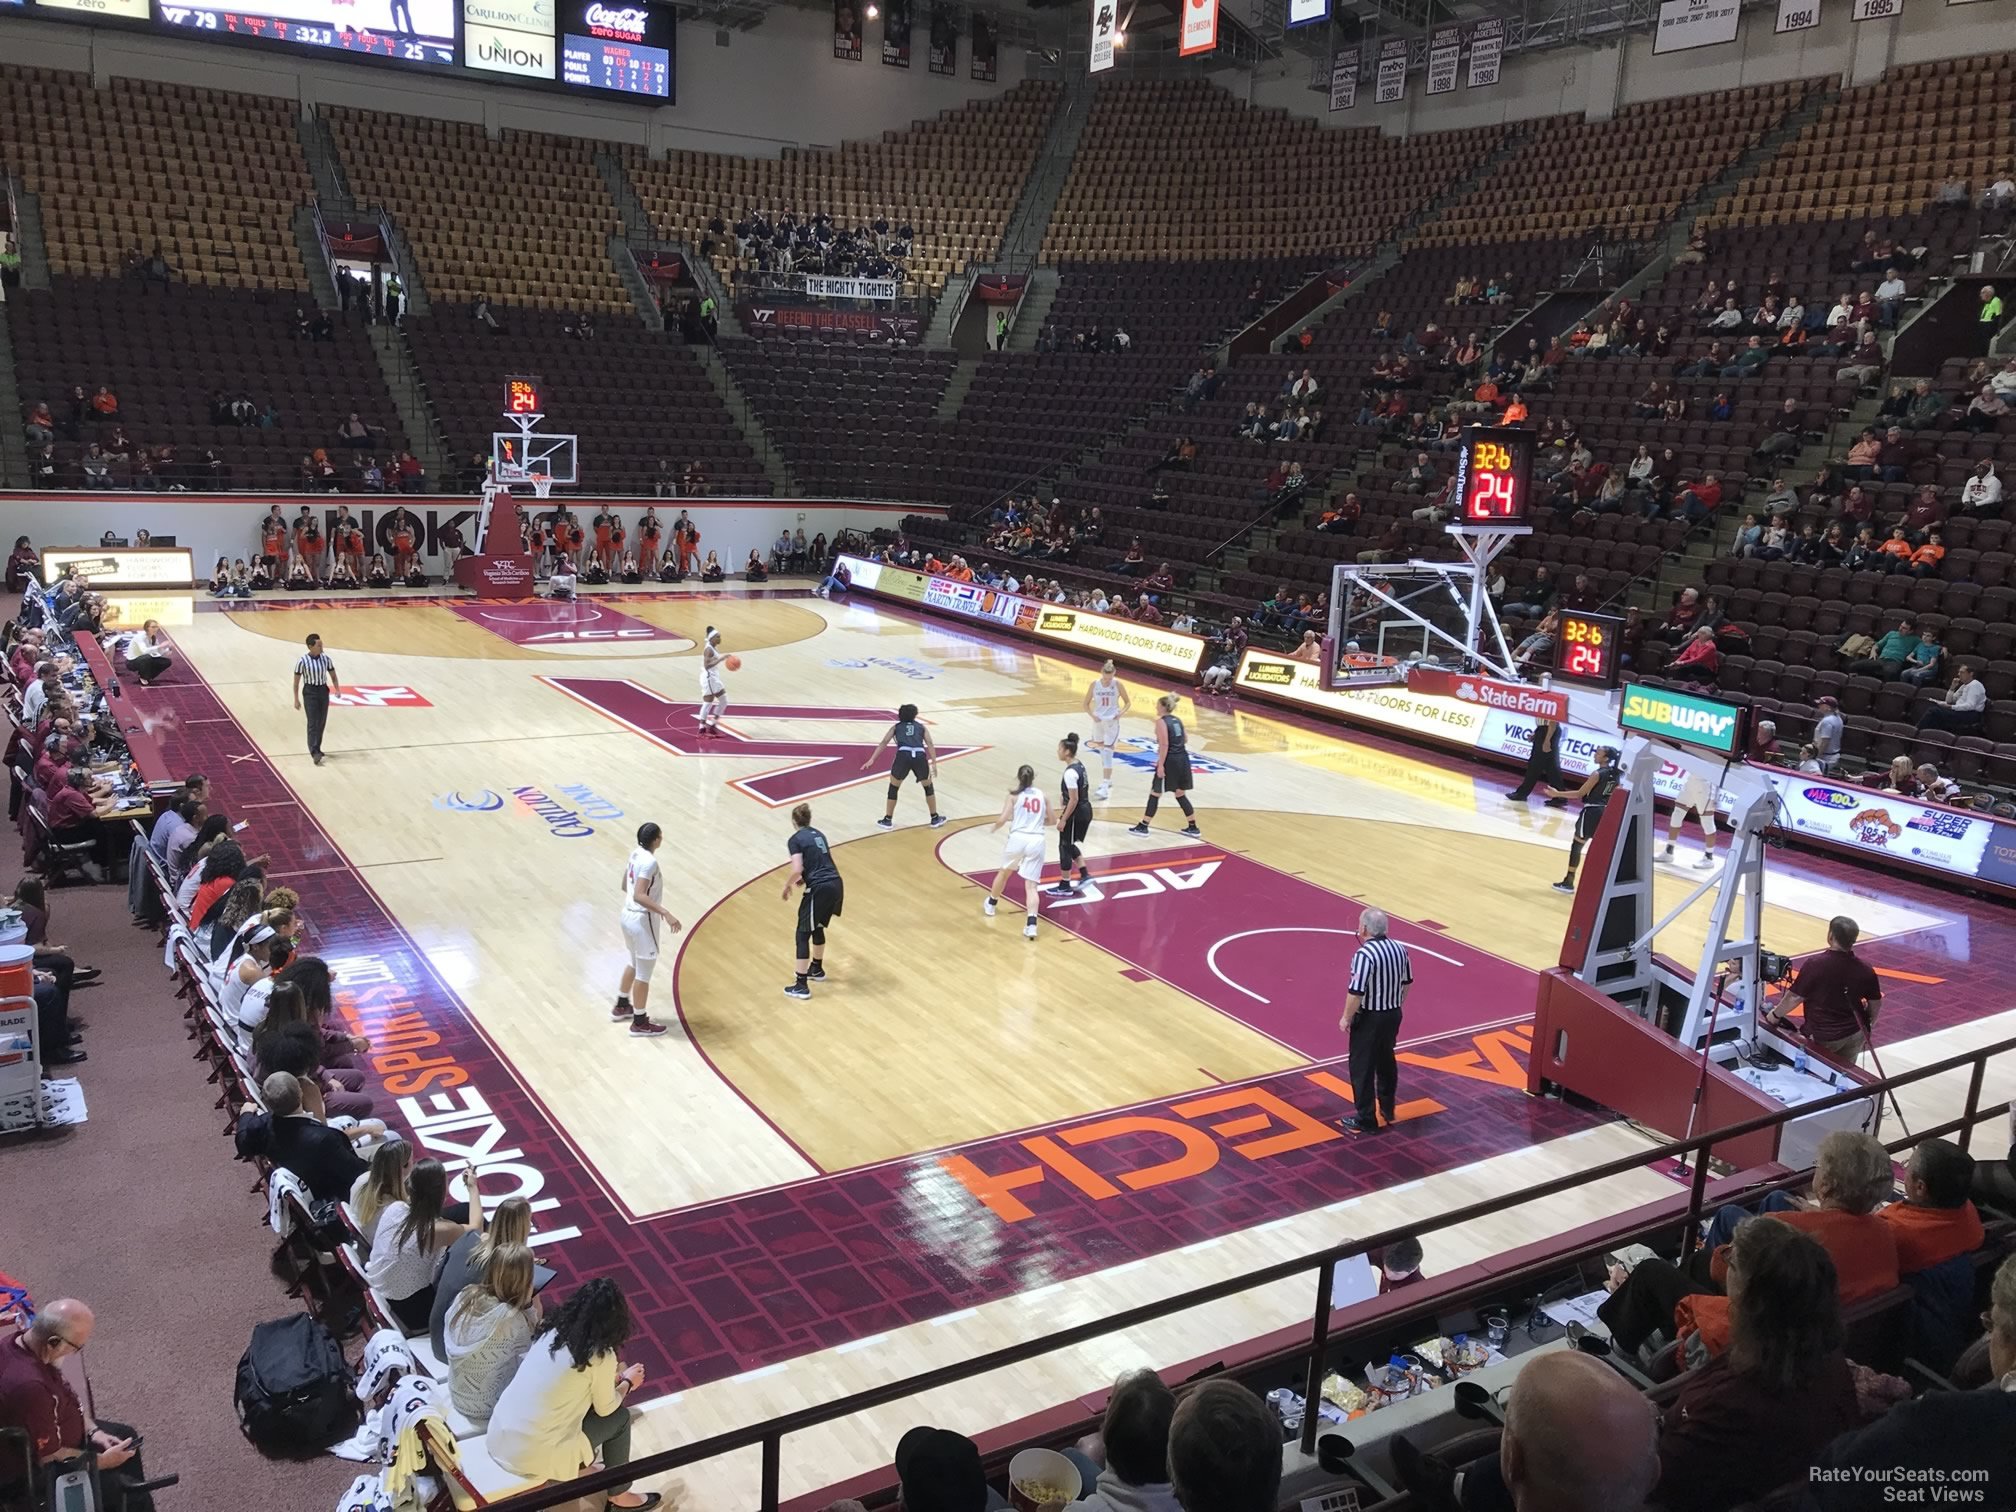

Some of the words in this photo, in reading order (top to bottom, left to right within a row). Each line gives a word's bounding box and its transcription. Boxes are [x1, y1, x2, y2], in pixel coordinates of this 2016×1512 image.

[1721, 8, 1735, 17] 2017
[1863, 0, 1894, 15] 1995
[194, 11, 216, 29] 79
[243, 17, 266, 28] FOULS
[274, 20, 287, 31] PER
[1187, 19, 1210, 33] CLEMSON
[1785, 10, 1812, 28] 1994
[253, 26, 258, 35] 3
[591, 27, 613, 38] zero
[614, 30, 641, 42] SUGAR
[1473, 28, 1502, 39] BASKETBALL
[359, 34, 378, 45] FOULS
[1095, 40, 1111, 51] BOSTON
[404, 42, 424, 59] 25
[479, 44, 543, 68] UNION
[604, 46, 630, 56] WAGNER
[1094, 52, 1111, 62] COLLEGE
[564, 50, 590, 61] PLAYER
[655, 63, 665, 72] 22
[564, 61, 587, 72] FOULS
[606, 67, 611, 76] 2
[631, 70, 636, 79] 2
[644, 72, 649, 81] 2
[1474, 70, 1494, 84] 1998
[564, 72, 590, 84] POINTS
[606, 78, 611, 87] 4
[631, 82, 637, 91] 4
[643, 83, 649, 92] 4
[1433, 78, 1450, 90] 1998
[1382, 89, 1398, 100] 1994
[1001, 275, 1006, 283] 5
[809, 279, 823, 292] THE
[859, 283, 894, 297] TIGHTIES
[753, 309, 775, 321] VT
[778, 311, 812, 325] DEFEND
[816, 313, 833, 326] THE
[835, 314, 875, 328] CASSELL
[512, 382, 531, 392] 32.6
[513, 393, 534, 410] 24
[1475, 444, 1510, 470] 32.6
[1475, 473, 1513, 516] 24
[926, 591, 950, 606] MARTIN
[951, 599, 976, 613] TRAVEL
[1043, 622, 1072, 630] LIQUIDATORS
[1567, 621, 1602, 645] 32.6
[528, 629, 655, 640] ACC
[1079, 624, 1121, 640] HARDWOOD
[1124, 634, 1154, 649] FLOORS
[1156, 643, 1172, 653] FOR
[1174, 647, 1196, 659] LESS!
[1573, 646, 1600, 672] 24
[1259, 665, 1285, 674] LUMBER
[1249, 672, 1290, 683] LIQUIDATORS
[1102, 697, 1109, 706] 11
[1414, 704, 1439, 718] FOR
[1441, 711, 1474, 728] LESS!
[1623, 696, 1735, 736] SUBWAY
[906, 725, 914, 736] 3
[1501, 743, 1515, 753] IMG
[1565, 738, 1598, 757] TECH
[1807, 789, 1829, 801] Mix
[507, 785, 594, 838] CARILION
[1021, 796, 1041, 814] 40
[1922, 810, 1972, 824] SUPER
[1037, 861, 1222, 908] ACC
